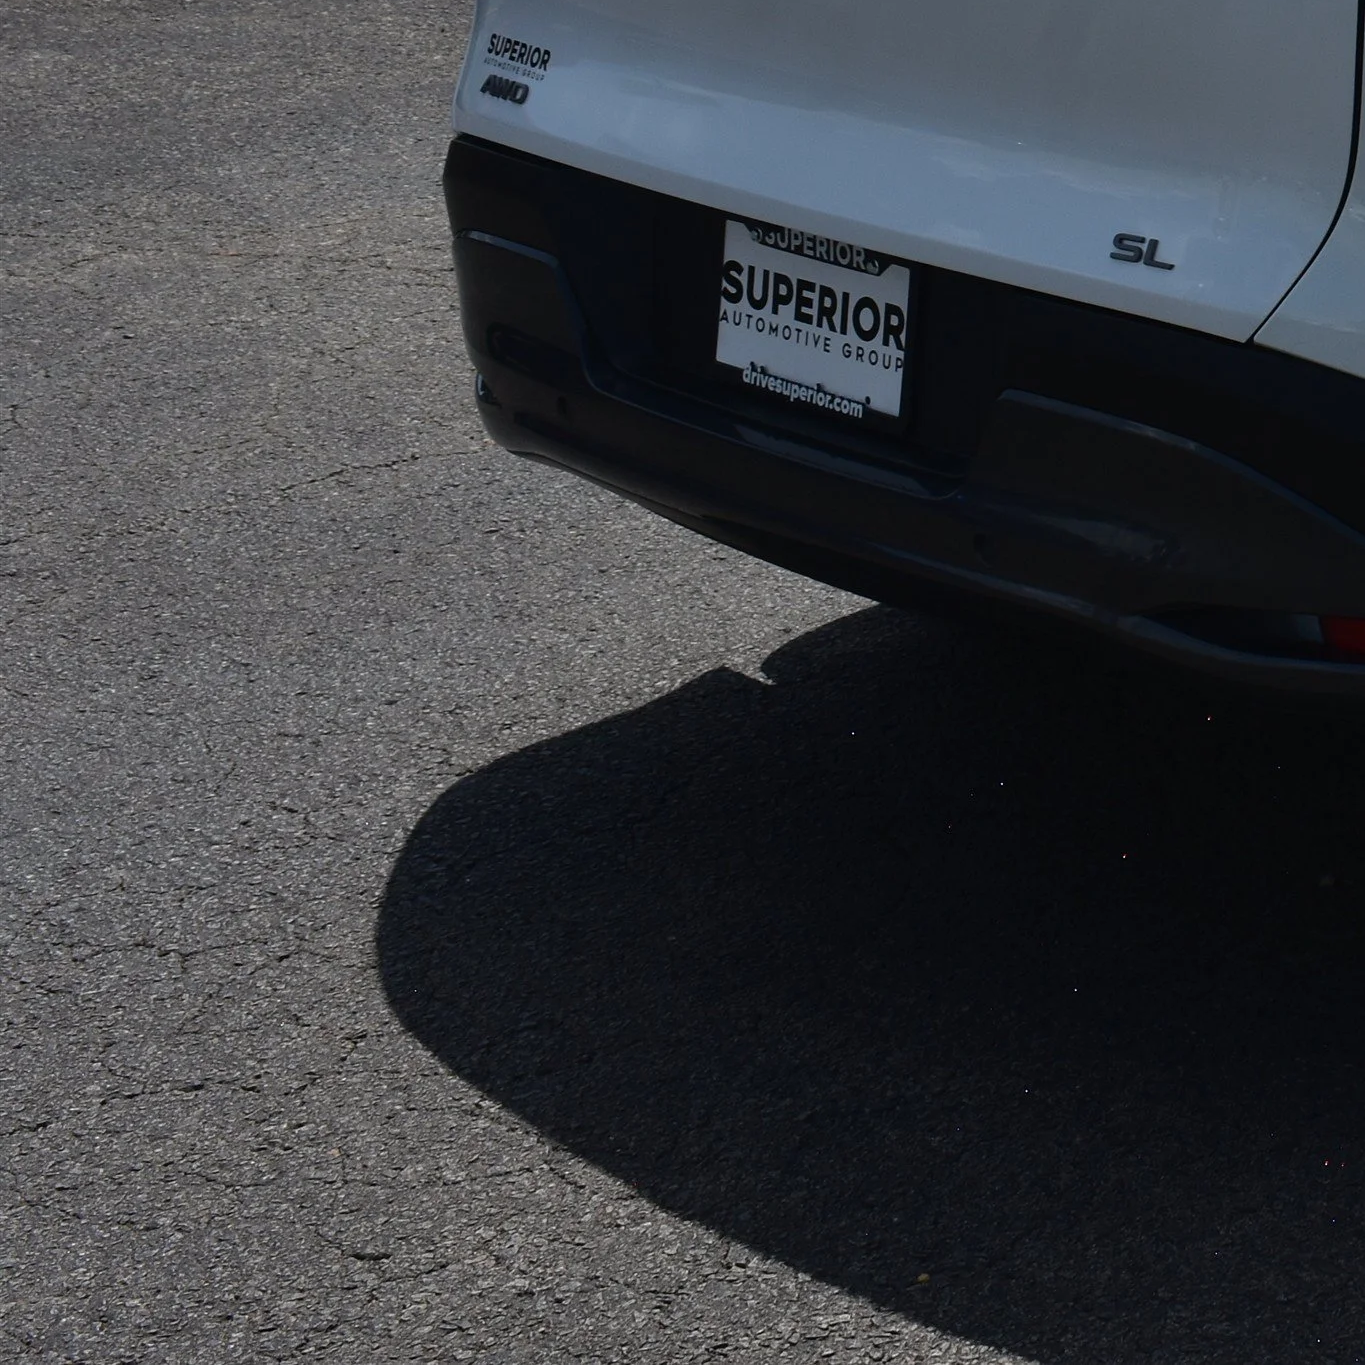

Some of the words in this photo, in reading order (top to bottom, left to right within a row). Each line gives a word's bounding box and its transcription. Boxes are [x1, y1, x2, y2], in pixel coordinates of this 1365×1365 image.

[487, 33, 551, 72] SUPERIOR
[480, 74, 530, 105] AWD
[765, 227, 866, 271] SUPERIOR
[1109, 232, 1176, 271] SL
[720, 259, 906, 352] SUPERIOR
[719, 308, 832, 354] AUTOMOTIVE
[841, 342, 905, 373] GROUP
[742, 364, 864, 419] drivesuperior.com
